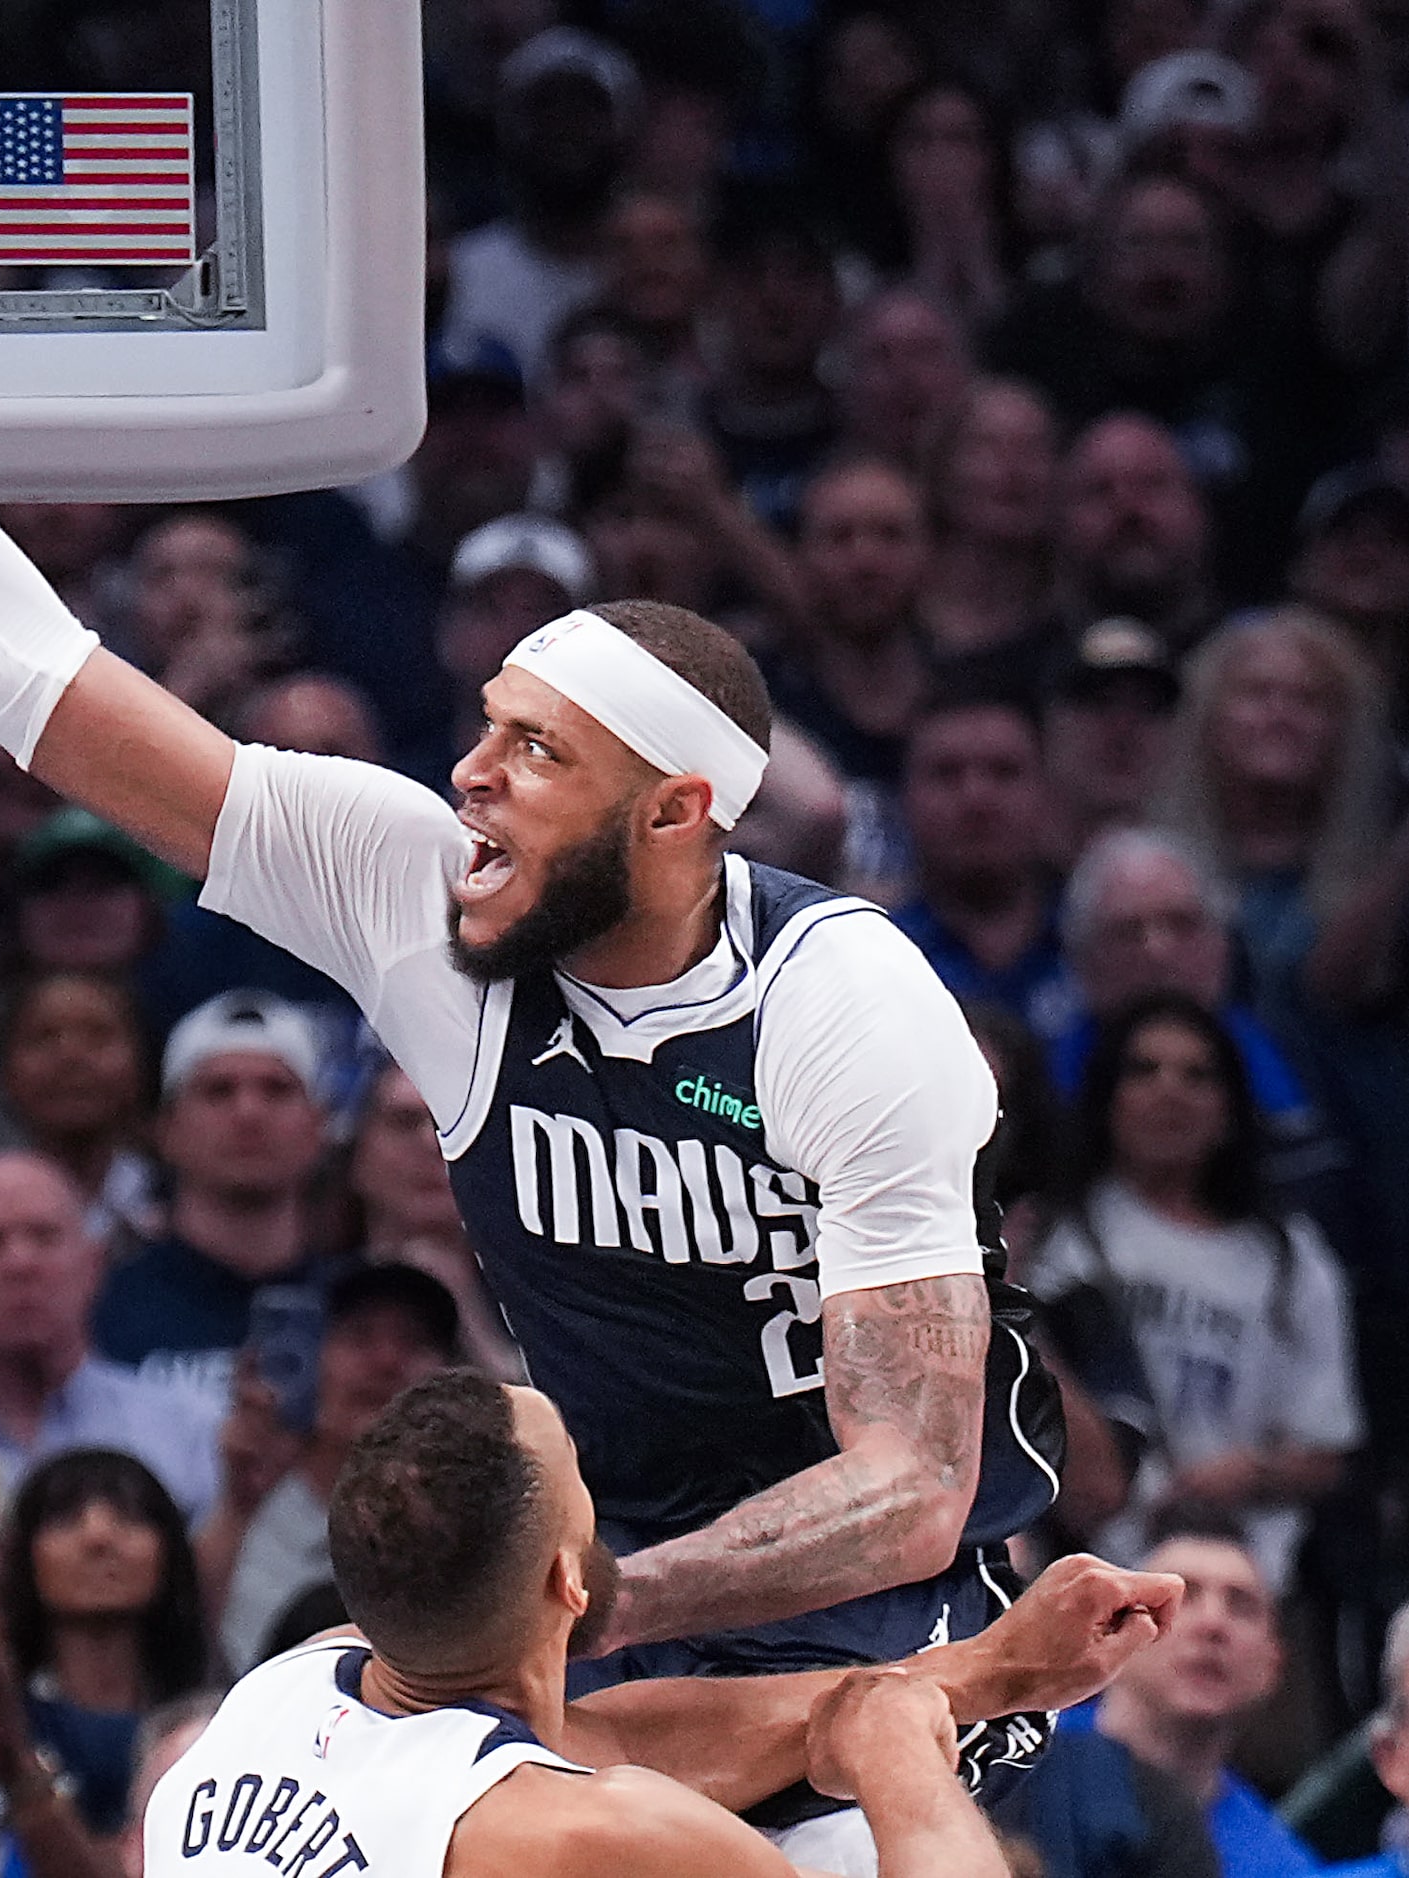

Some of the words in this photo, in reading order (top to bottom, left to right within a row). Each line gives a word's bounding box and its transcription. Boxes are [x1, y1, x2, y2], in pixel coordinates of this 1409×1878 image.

[675, 1076, 761, 1129] chime
[510, 1104, 822, 1270] MAVS
[182, 1773, 369, 1877] GOBERT
